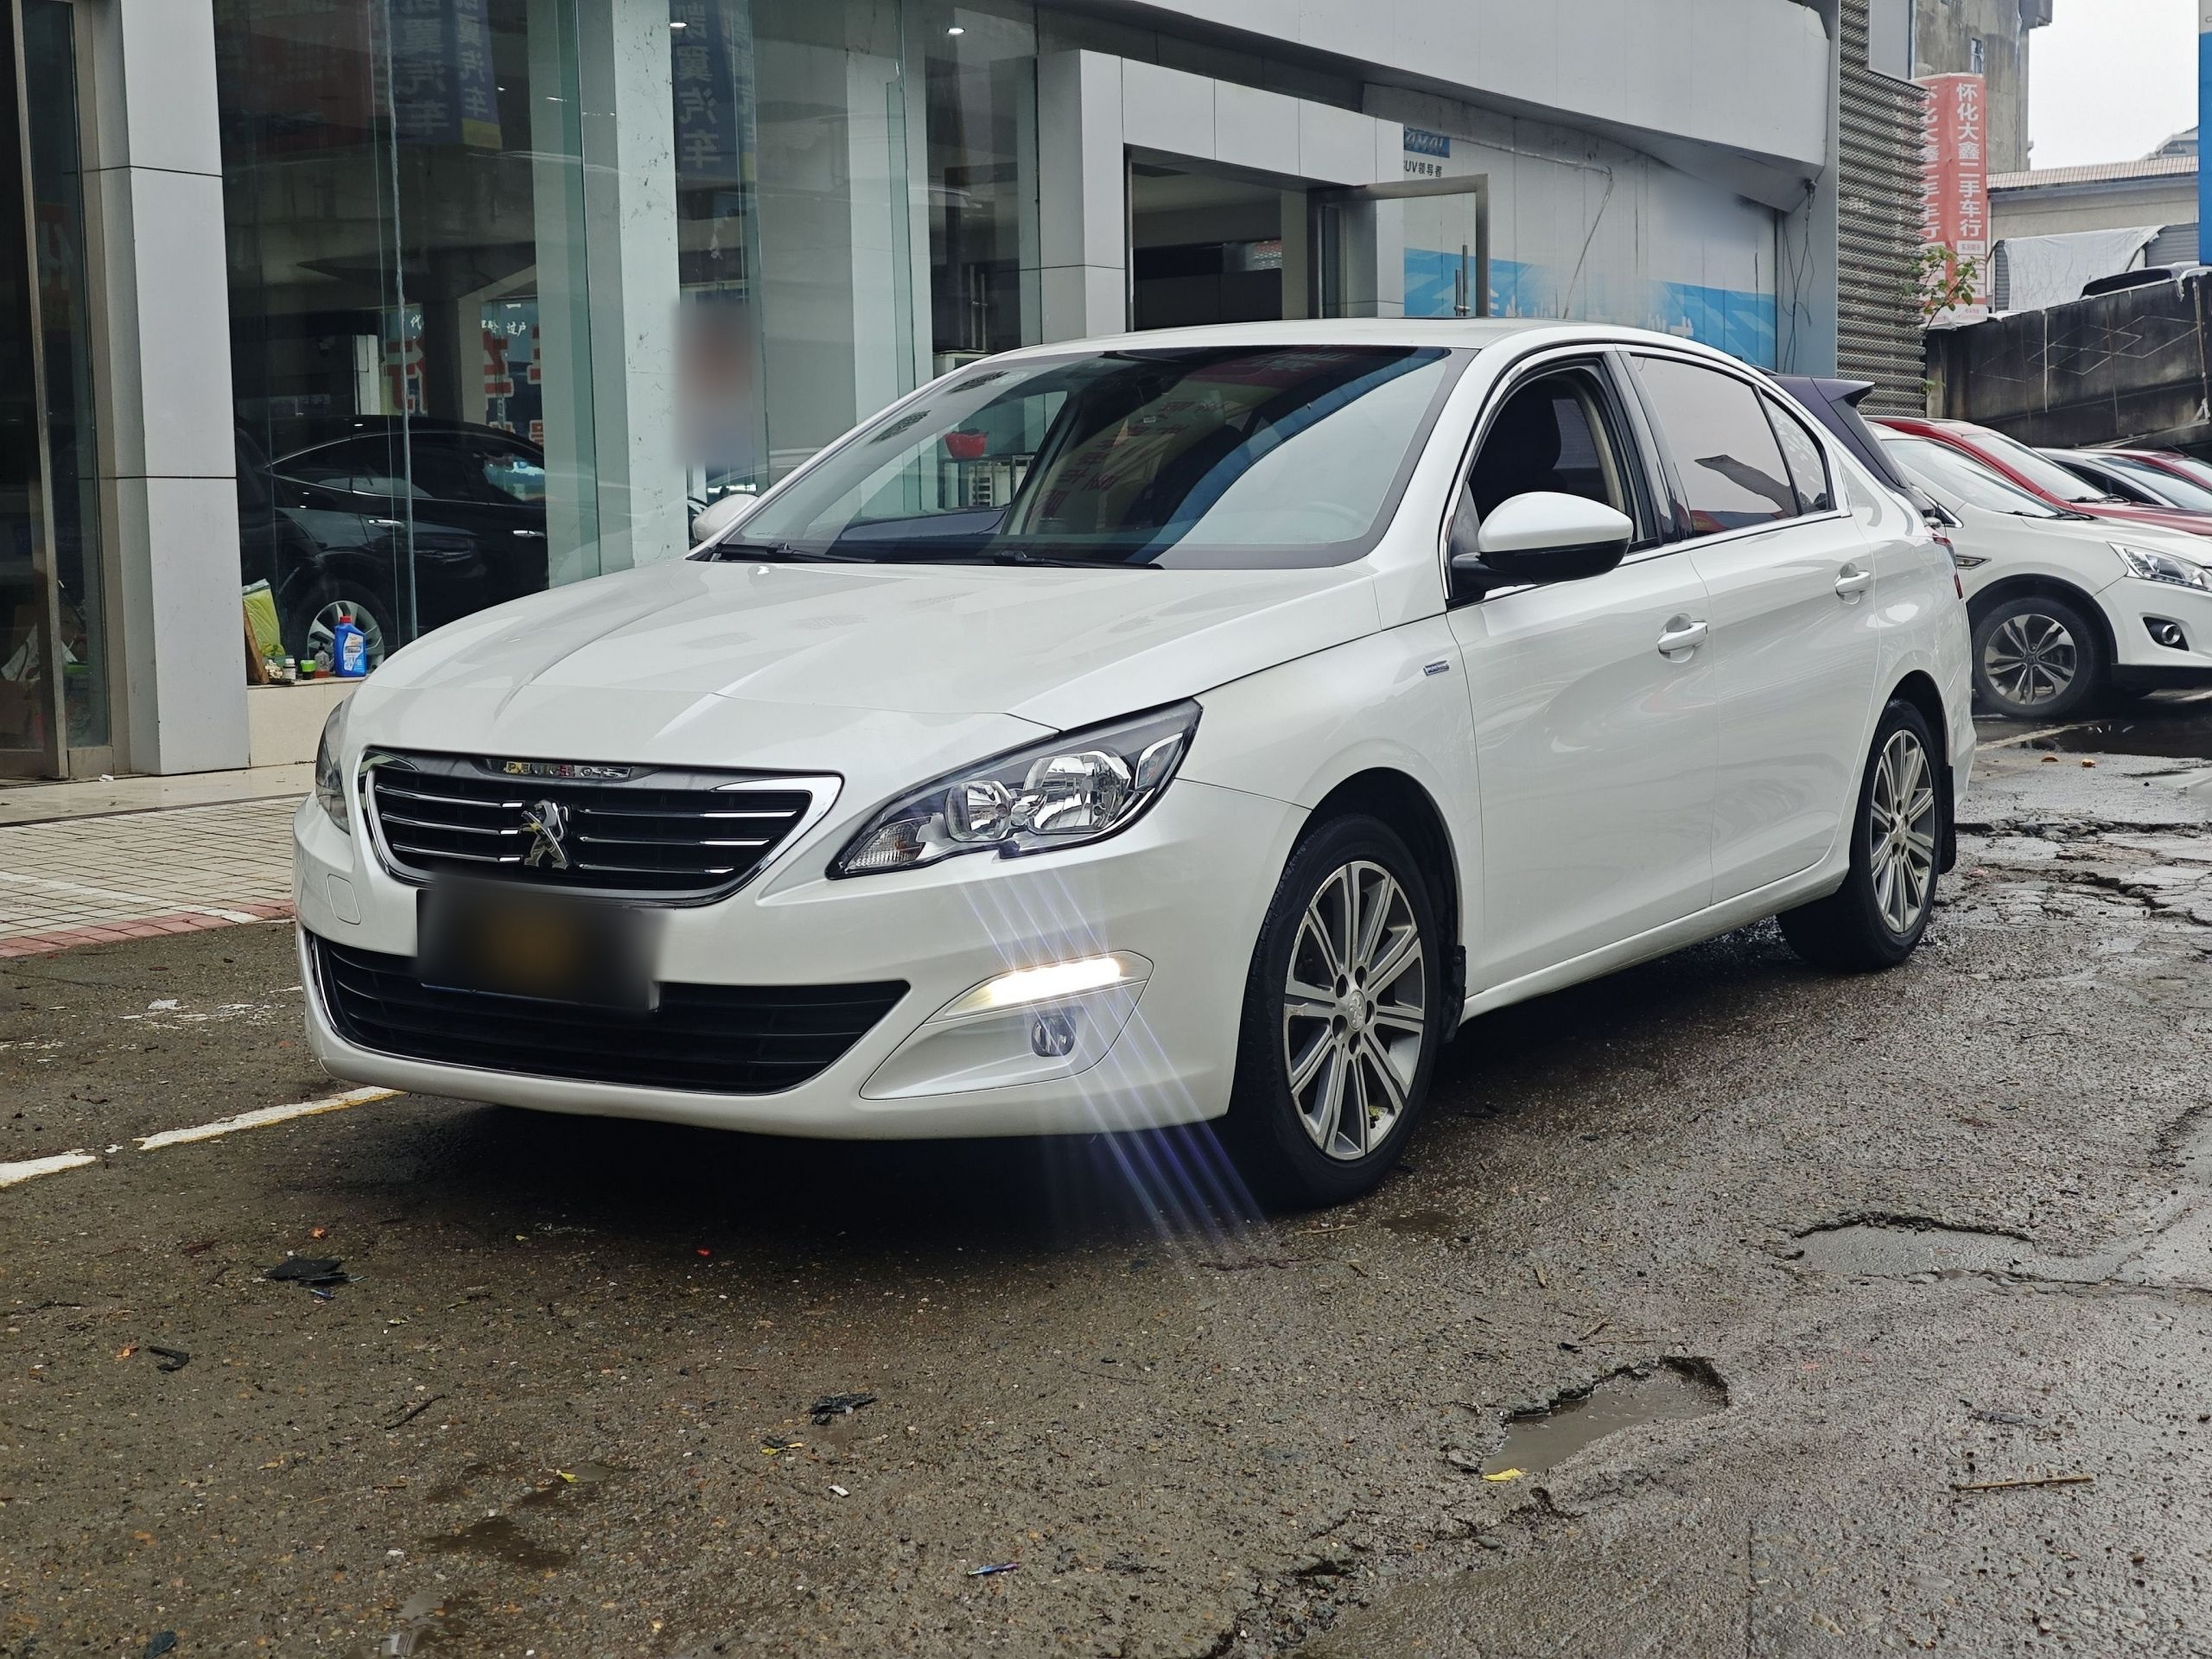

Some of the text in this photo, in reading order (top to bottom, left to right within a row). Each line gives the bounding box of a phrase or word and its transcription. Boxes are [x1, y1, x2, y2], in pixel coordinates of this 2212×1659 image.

[1404, 160, 1442, 177] UV领导者
[1956, 82, 1982, 237] 怀化大鑫二手车行
